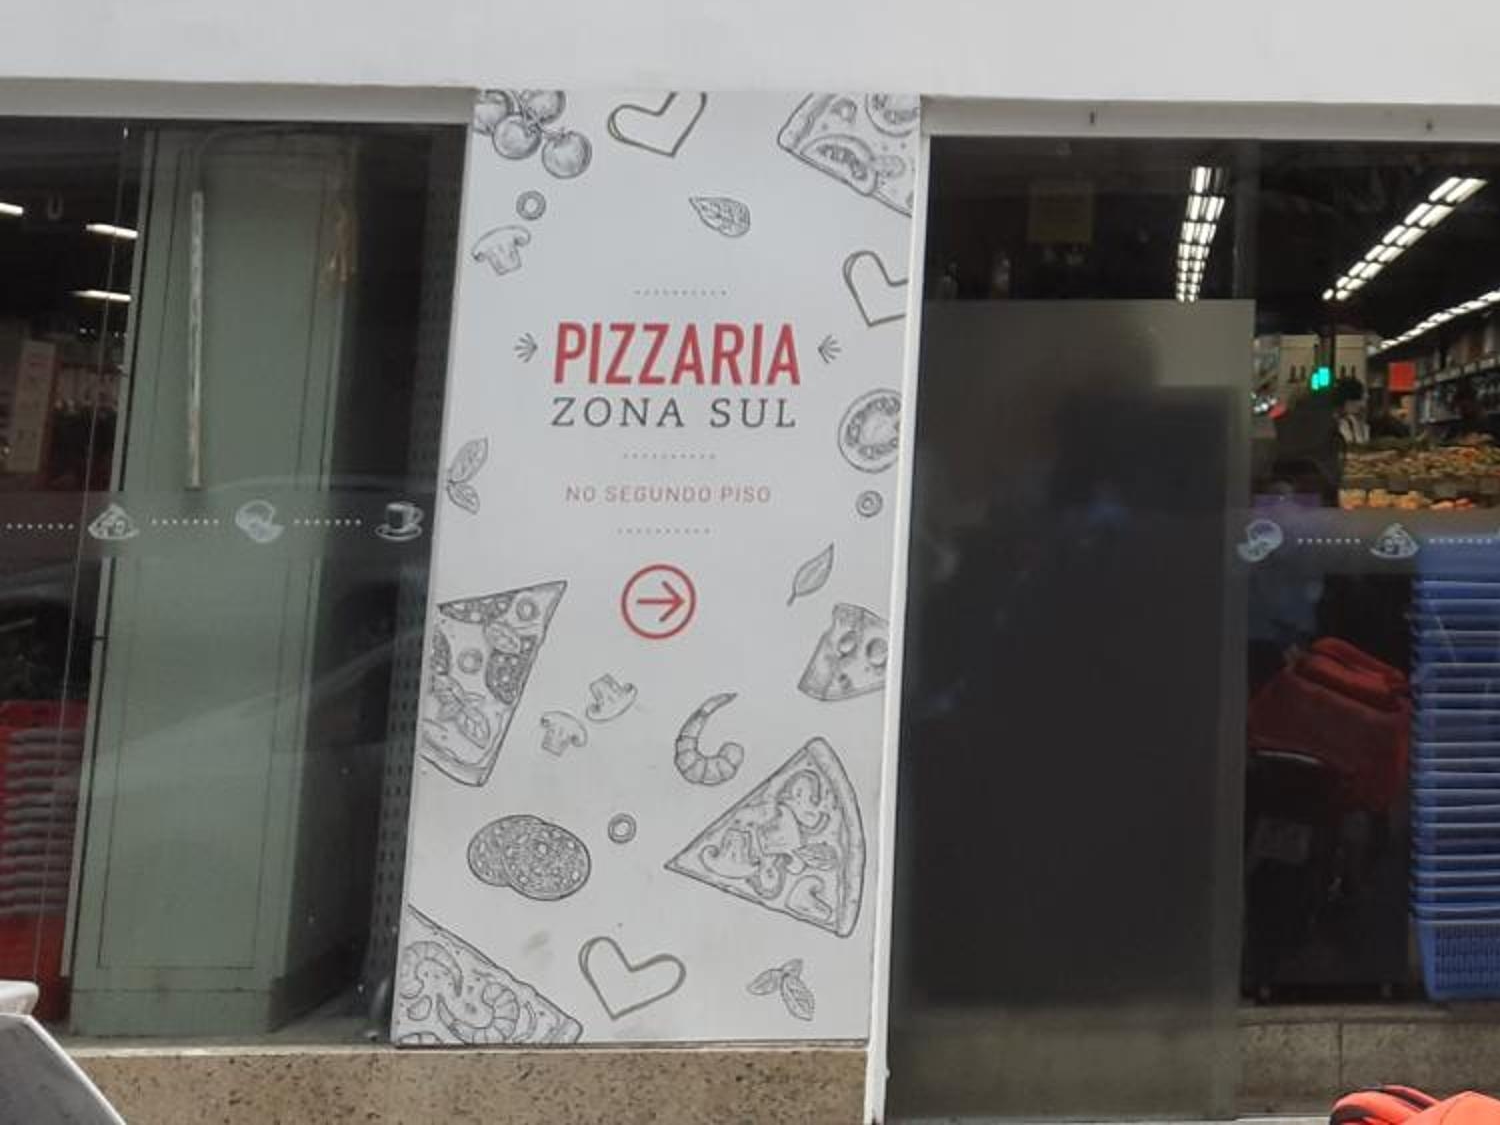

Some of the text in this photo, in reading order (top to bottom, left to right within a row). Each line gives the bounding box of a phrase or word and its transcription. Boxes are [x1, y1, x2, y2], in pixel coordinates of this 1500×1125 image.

[553, 321, 801, 386] PIZZARIA
[551, 396, 797, 428] ZONA SUL
[565, 485, 771, 504] NO SEGUNDO PISO
